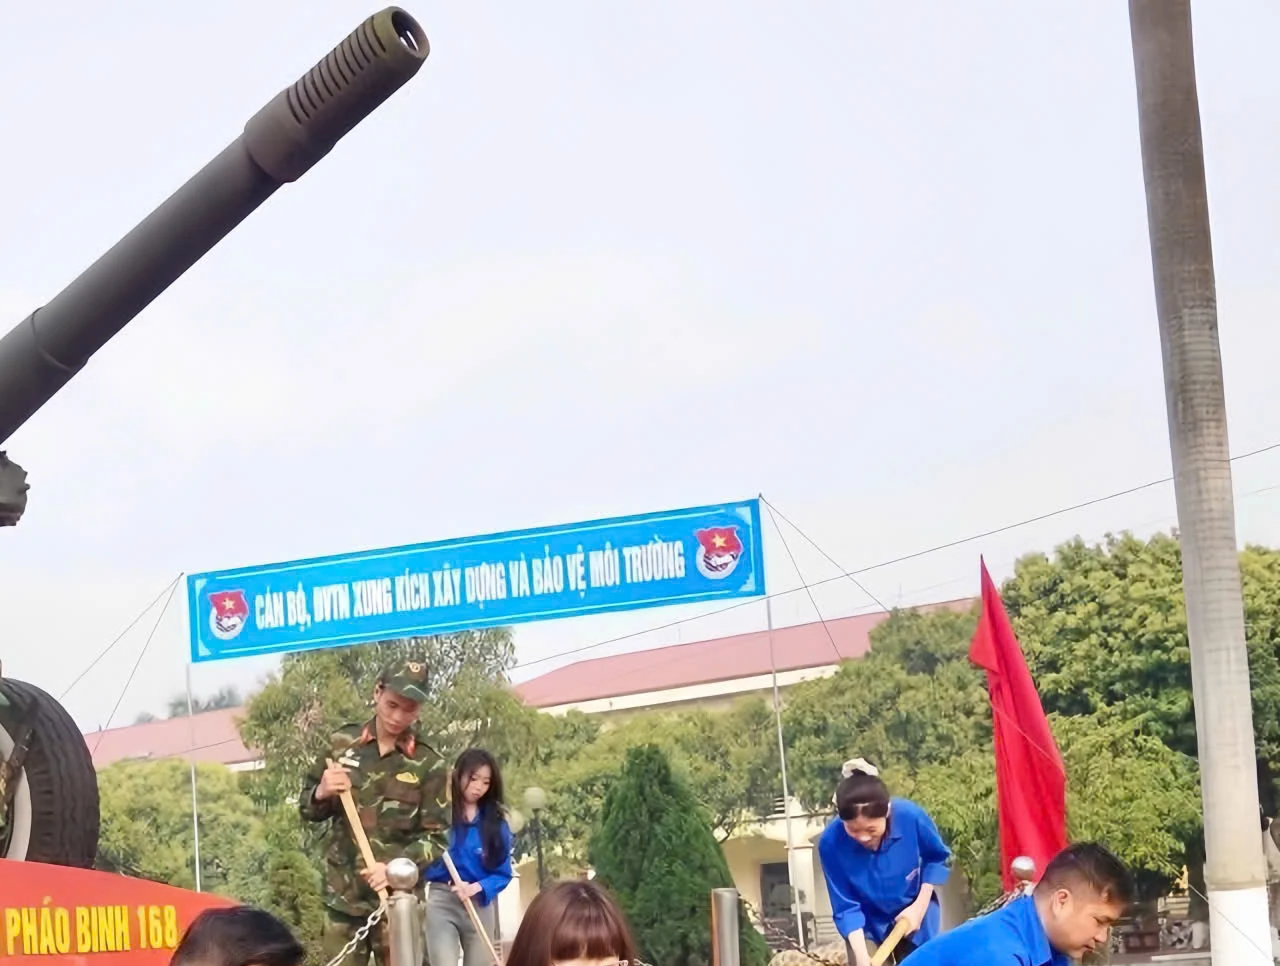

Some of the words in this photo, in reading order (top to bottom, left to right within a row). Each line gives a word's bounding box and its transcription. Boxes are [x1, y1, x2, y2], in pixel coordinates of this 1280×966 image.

[255, 585, 285, 630] CÁN
[352, 578, 393, 617] XUNG
[395, 568, 430, 612] KÍCH
[432, 562, 461, 608] XÂY
[509, 552, 531, 597] VÀ
[532, 544, 564, 595] BẢO
[566, 544, 586, 599] VỆ
[589, 541, 620, 588] MÔI
[623, 534, 686, 583] TRƯỜNG
[5, 896, 71, 956] PHÁO
[75, 905, 131, 953] BINH
[137, 905, 178, 950] 168
